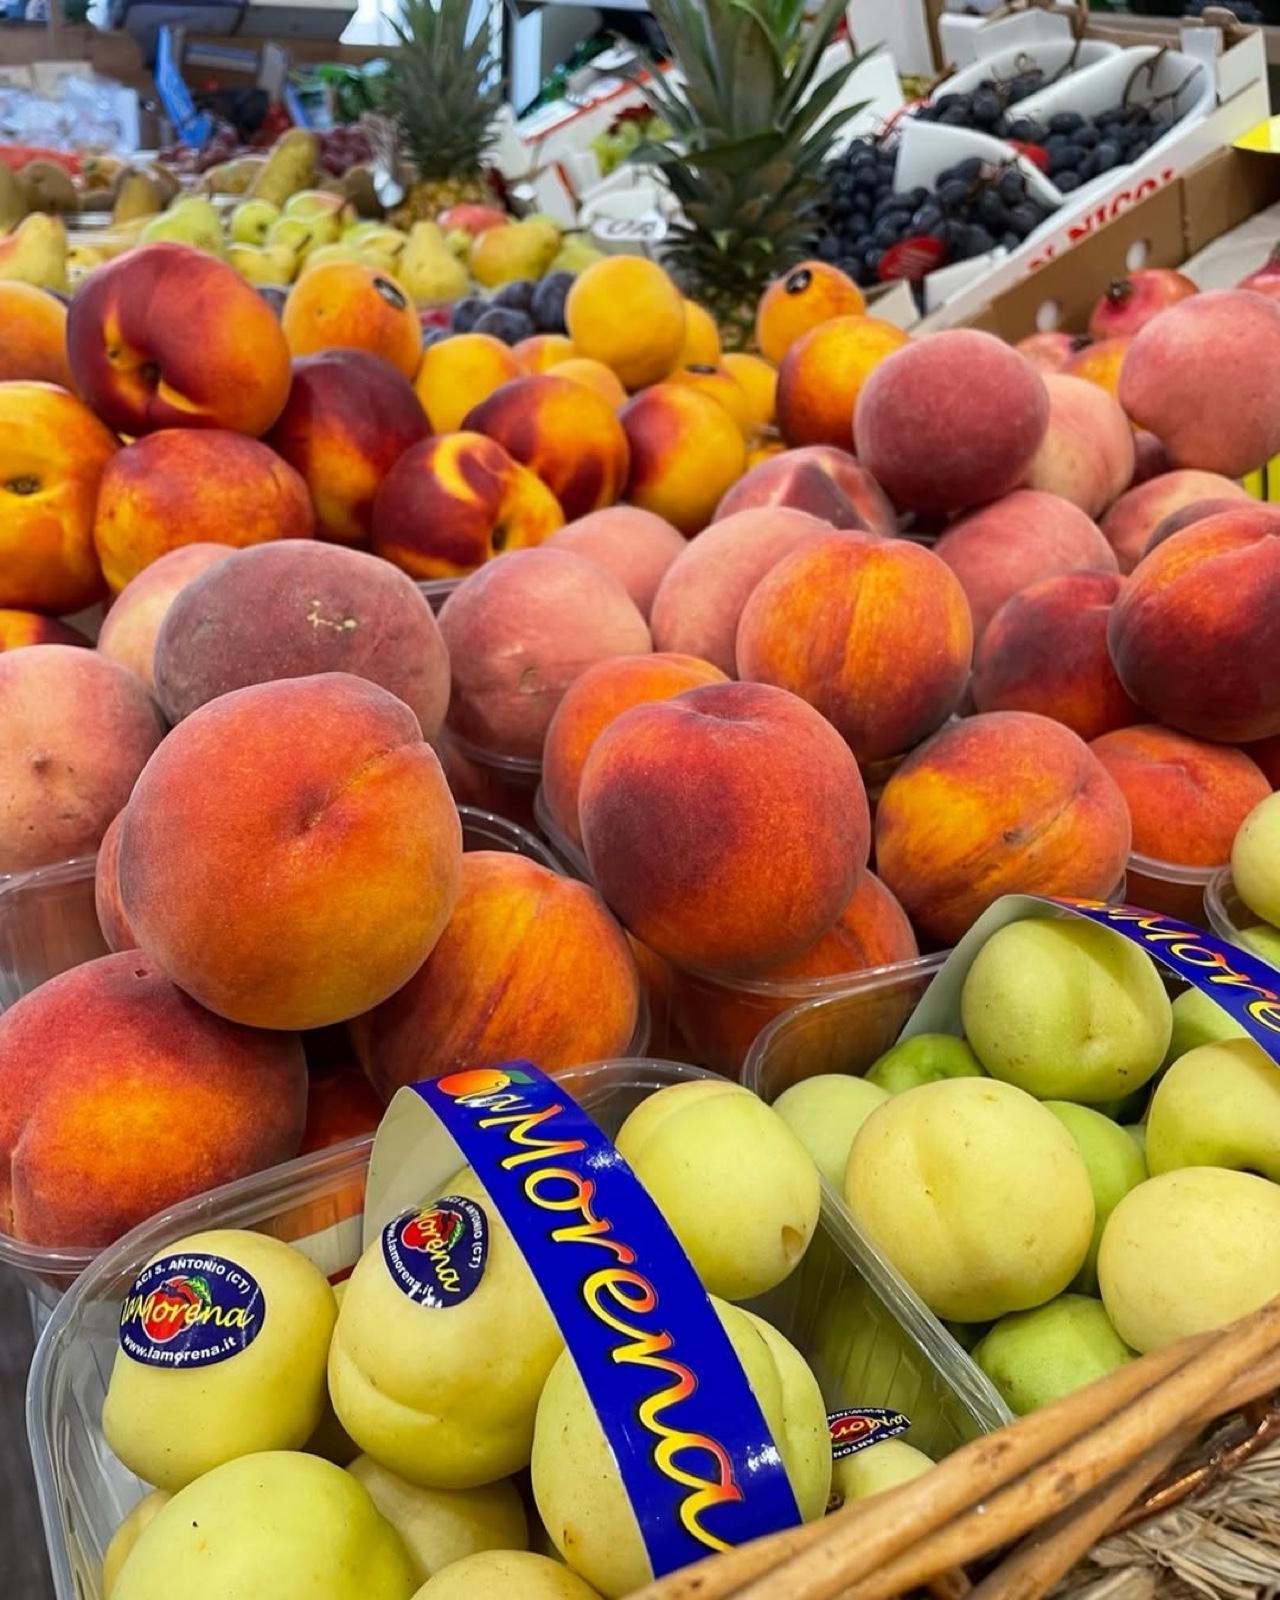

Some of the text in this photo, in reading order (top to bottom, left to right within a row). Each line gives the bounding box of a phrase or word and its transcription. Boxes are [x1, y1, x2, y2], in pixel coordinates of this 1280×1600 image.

[135, 1259, 251, 1294] ACI S. ANTONIO (CT)
[123, 1333, 237, 1363] www.lamorena.it
